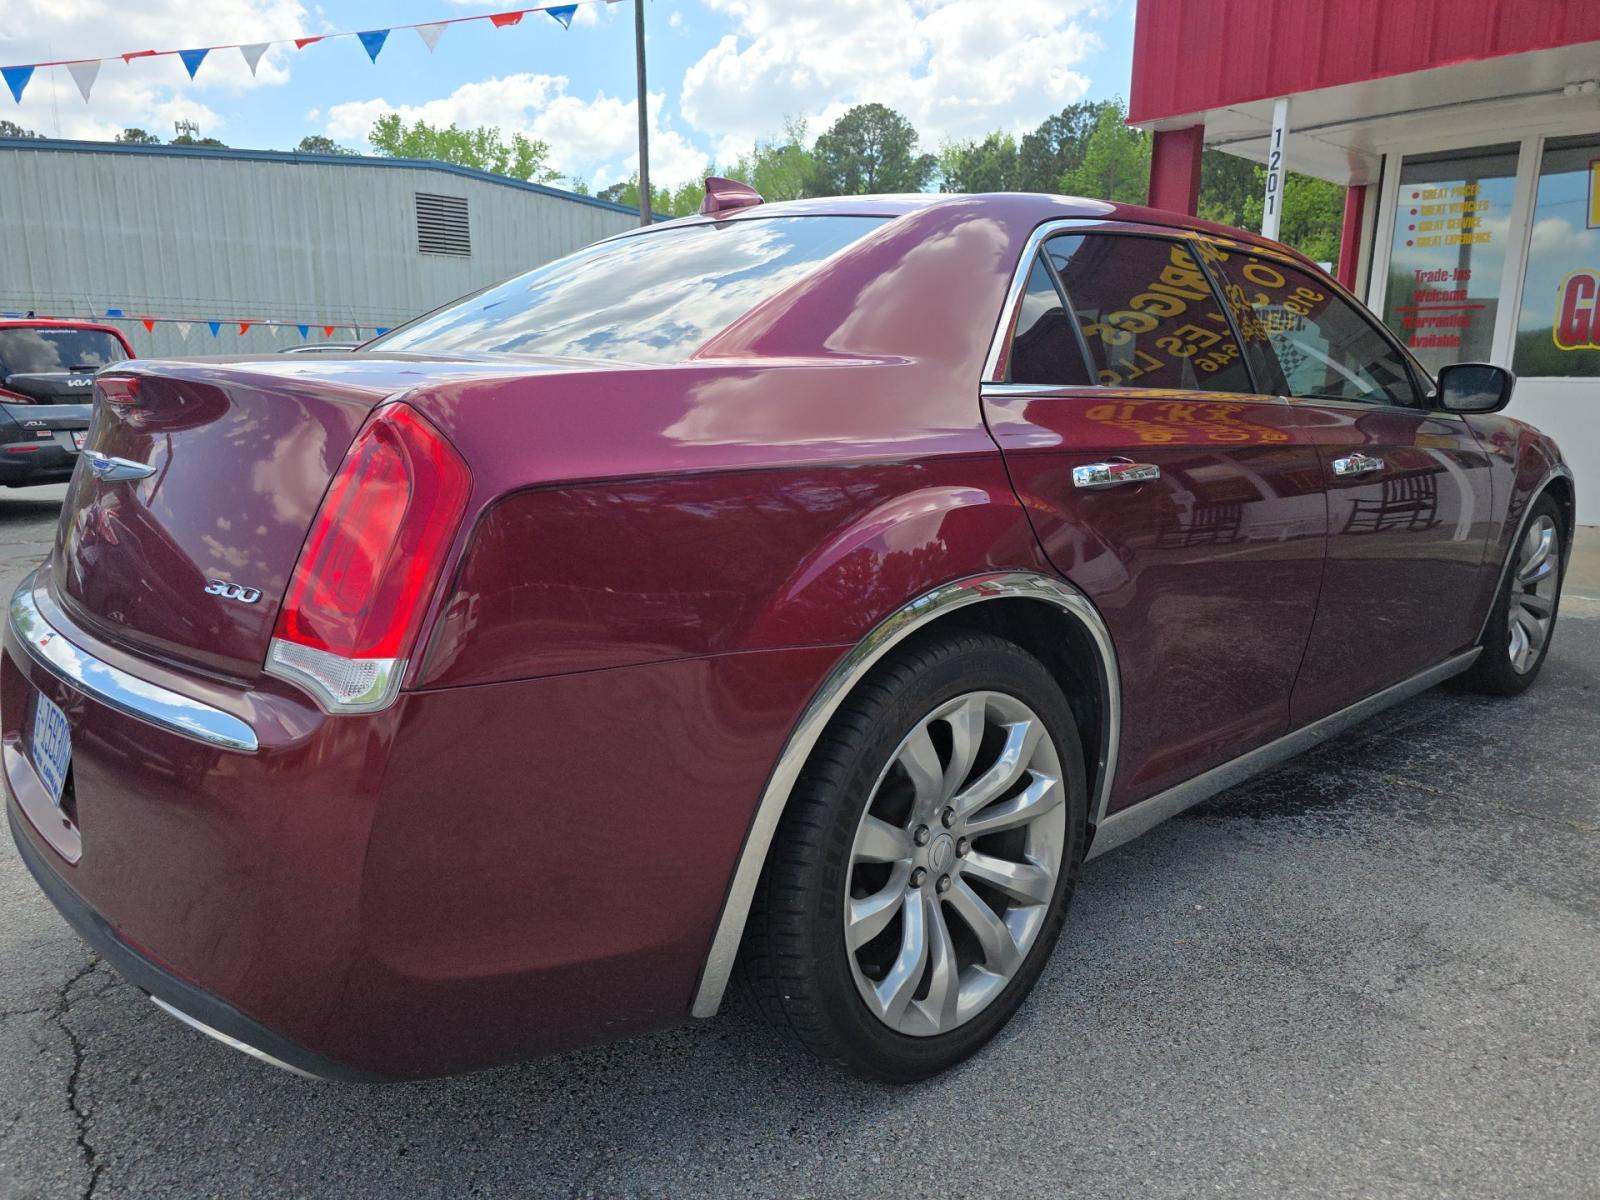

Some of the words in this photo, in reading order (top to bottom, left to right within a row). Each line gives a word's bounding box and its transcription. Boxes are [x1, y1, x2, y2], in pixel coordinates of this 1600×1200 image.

[1267, 127, 1283, 215] 1201
[1414, 267, 1472, 283] Trade-Ins
[1412, 288, 1467, 302] Welcome
[1408, 333, 1461, 348] Available
[204, 578, 263, 604] 300
